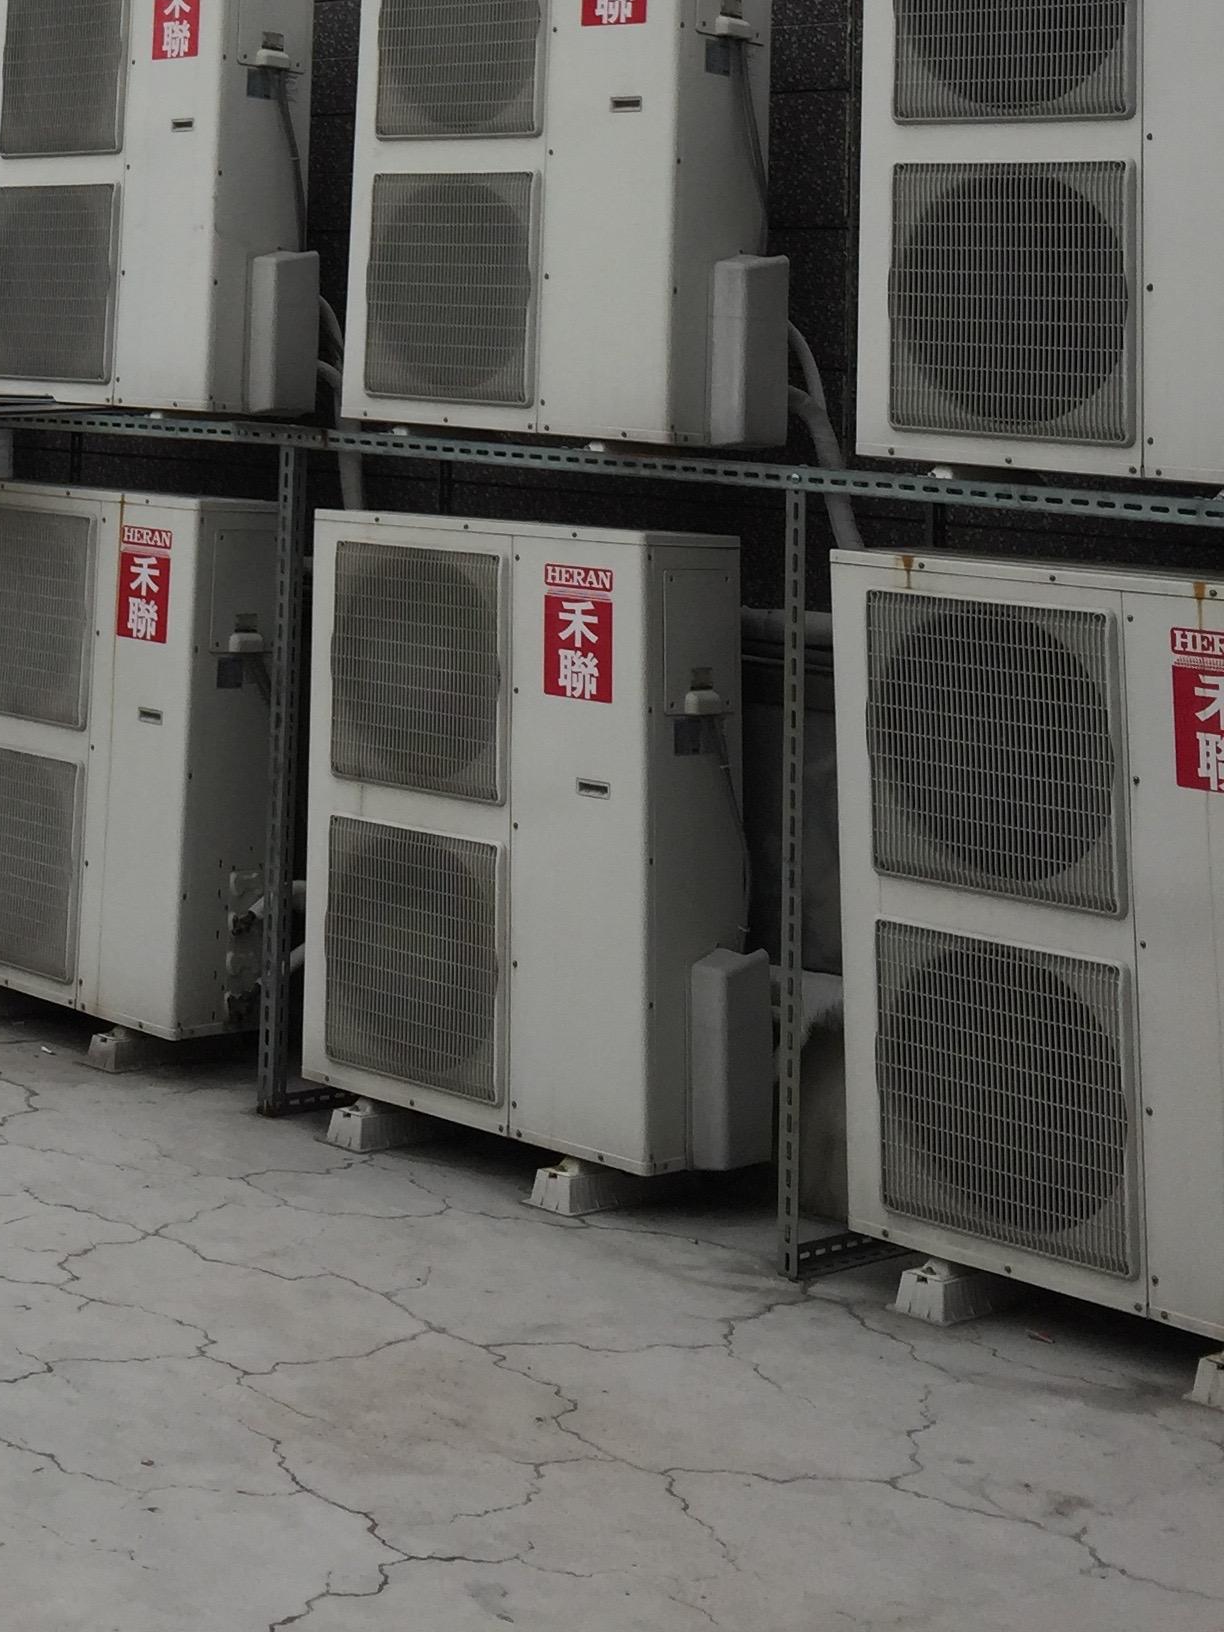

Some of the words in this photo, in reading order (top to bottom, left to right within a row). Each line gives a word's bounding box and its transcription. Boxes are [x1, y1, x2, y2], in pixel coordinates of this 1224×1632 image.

[123, 528, 171, 546] HERAN
[546, 566, 611, 588] HERAN
[128, 556, 159, 640] 禾聯
[558, 601, 599, 698] 禾聯
[1173, 631, 1224, 655] HER
